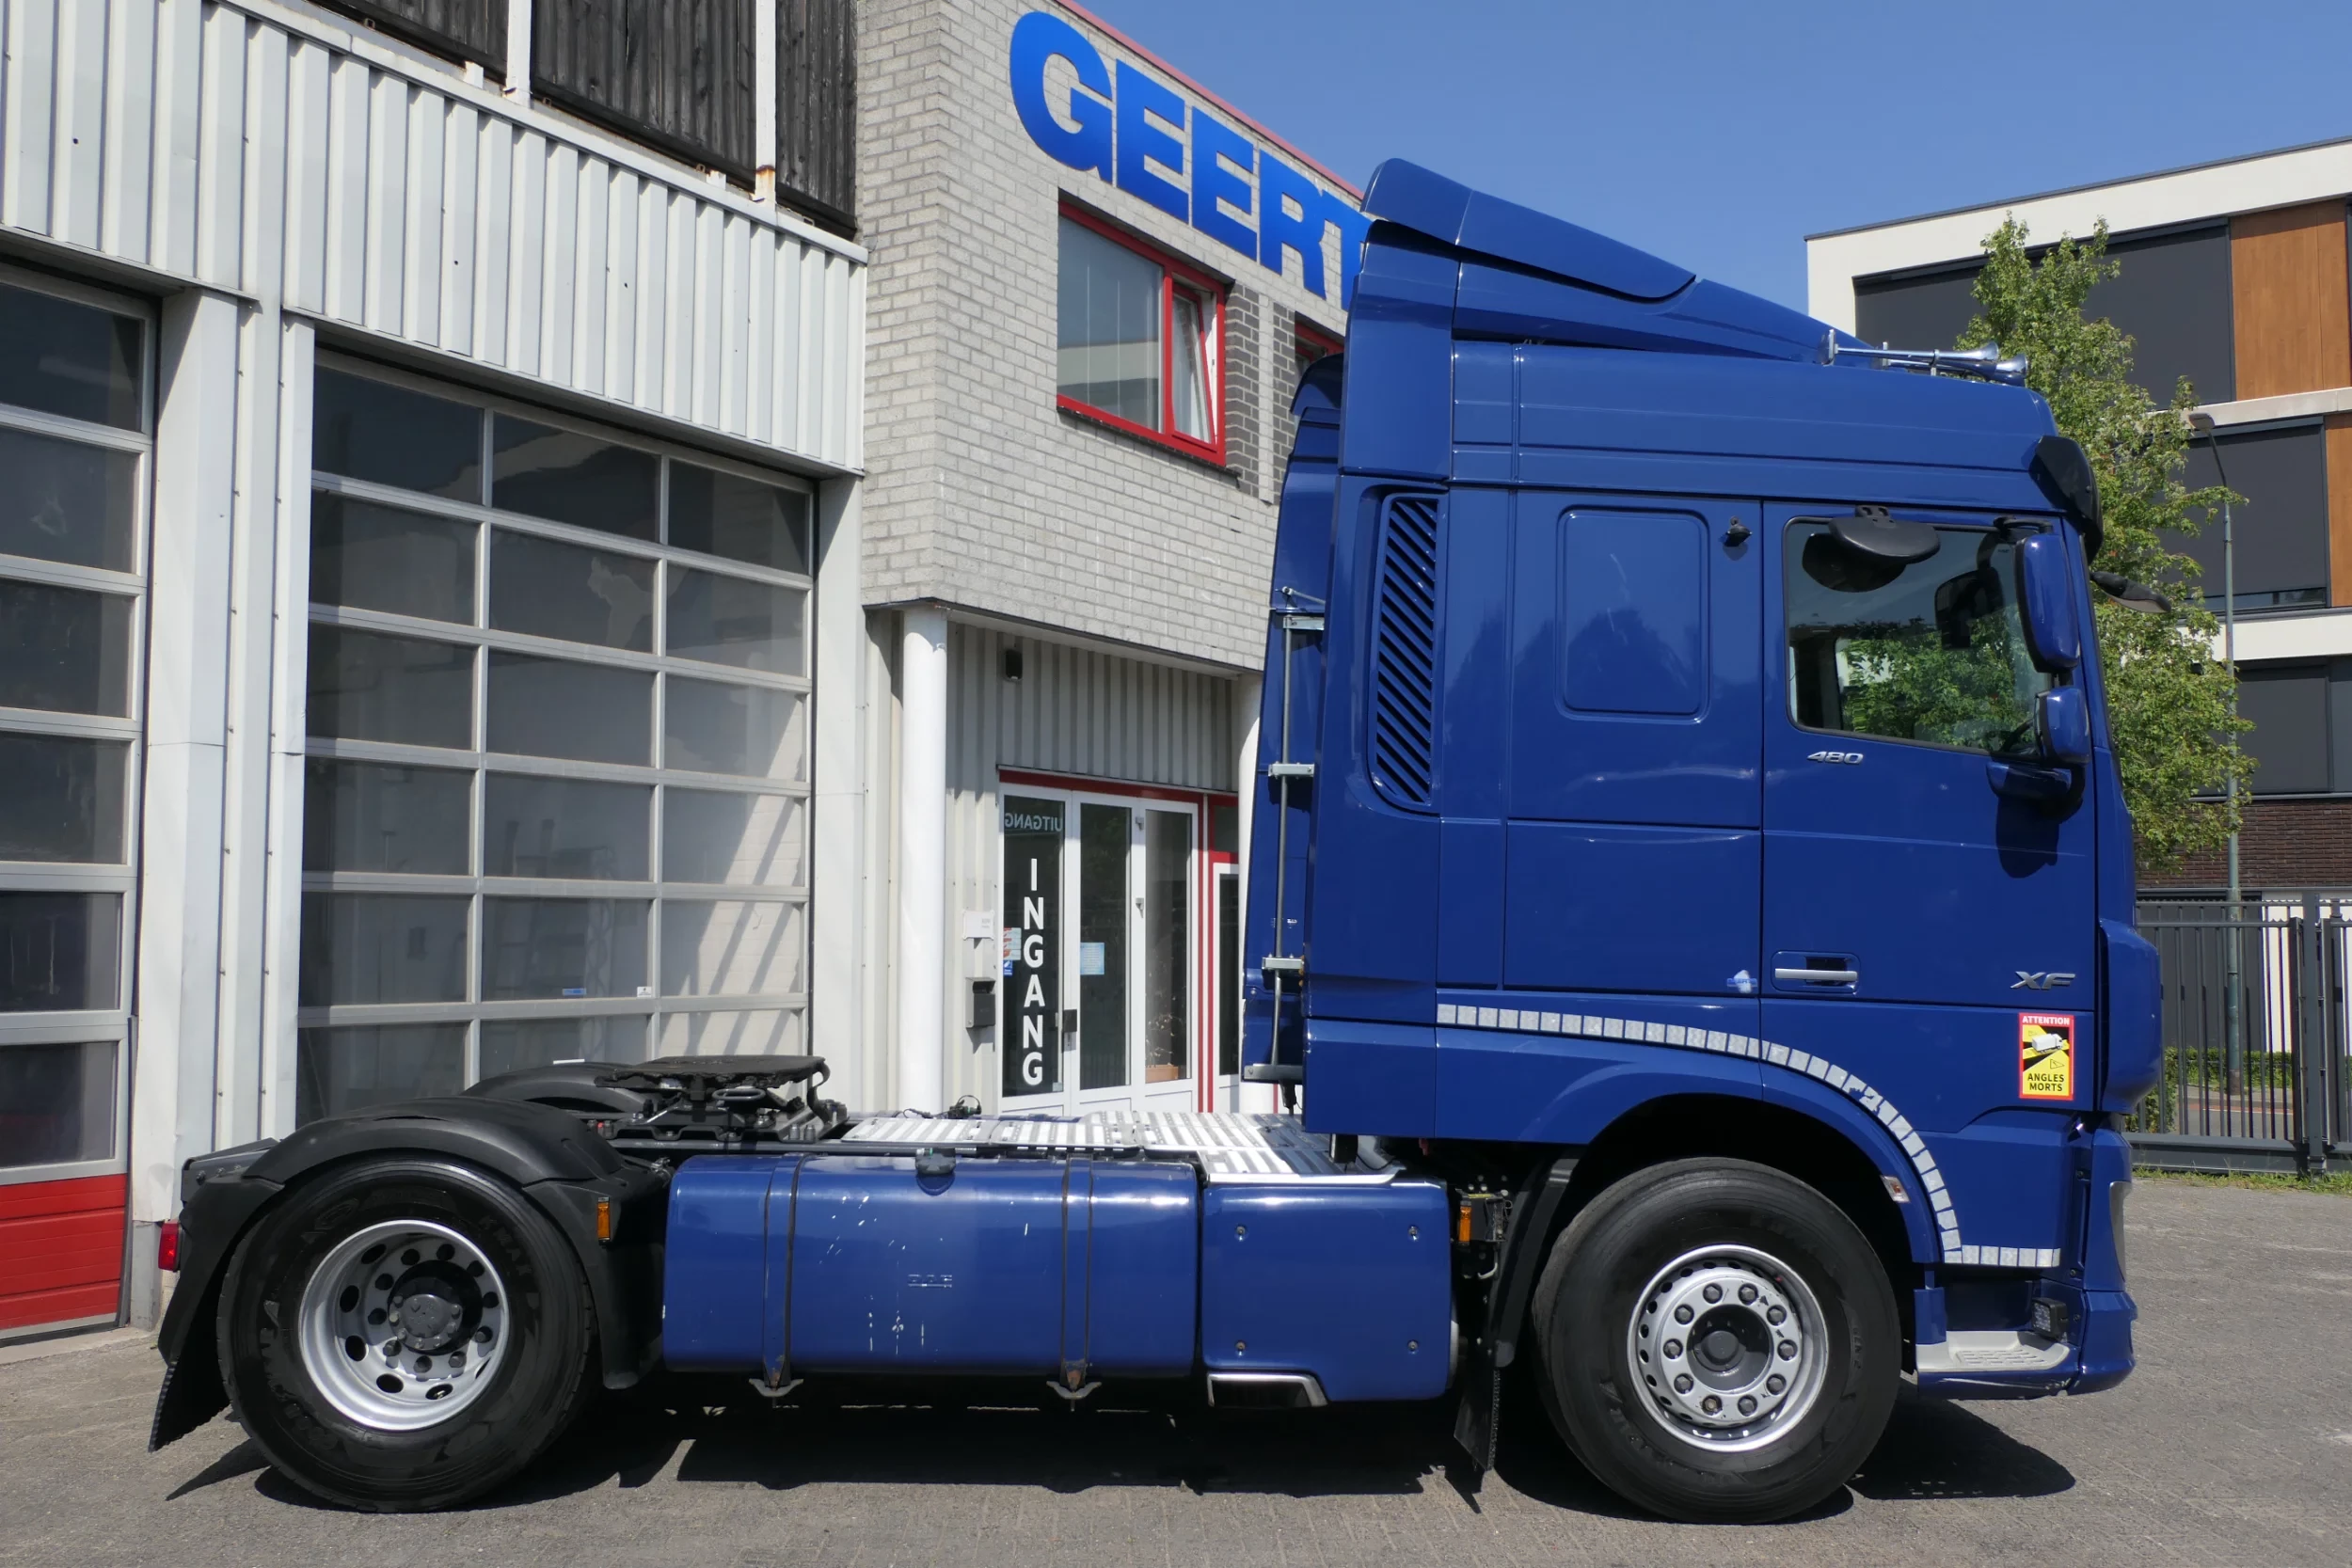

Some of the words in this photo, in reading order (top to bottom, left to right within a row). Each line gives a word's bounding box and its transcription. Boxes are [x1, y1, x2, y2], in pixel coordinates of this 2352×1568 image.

[1806, 751, 1864, 765] 480
[1023, 858, 1045, 1085] INGANG
[2010, 971, 2075, 990] XF
[2022, 1015, 2070, 1025] ATTENTION
[2027, 1073, 2065, 1083] ANGLES
[2029, 1083, 2063, 1092] MORTS
